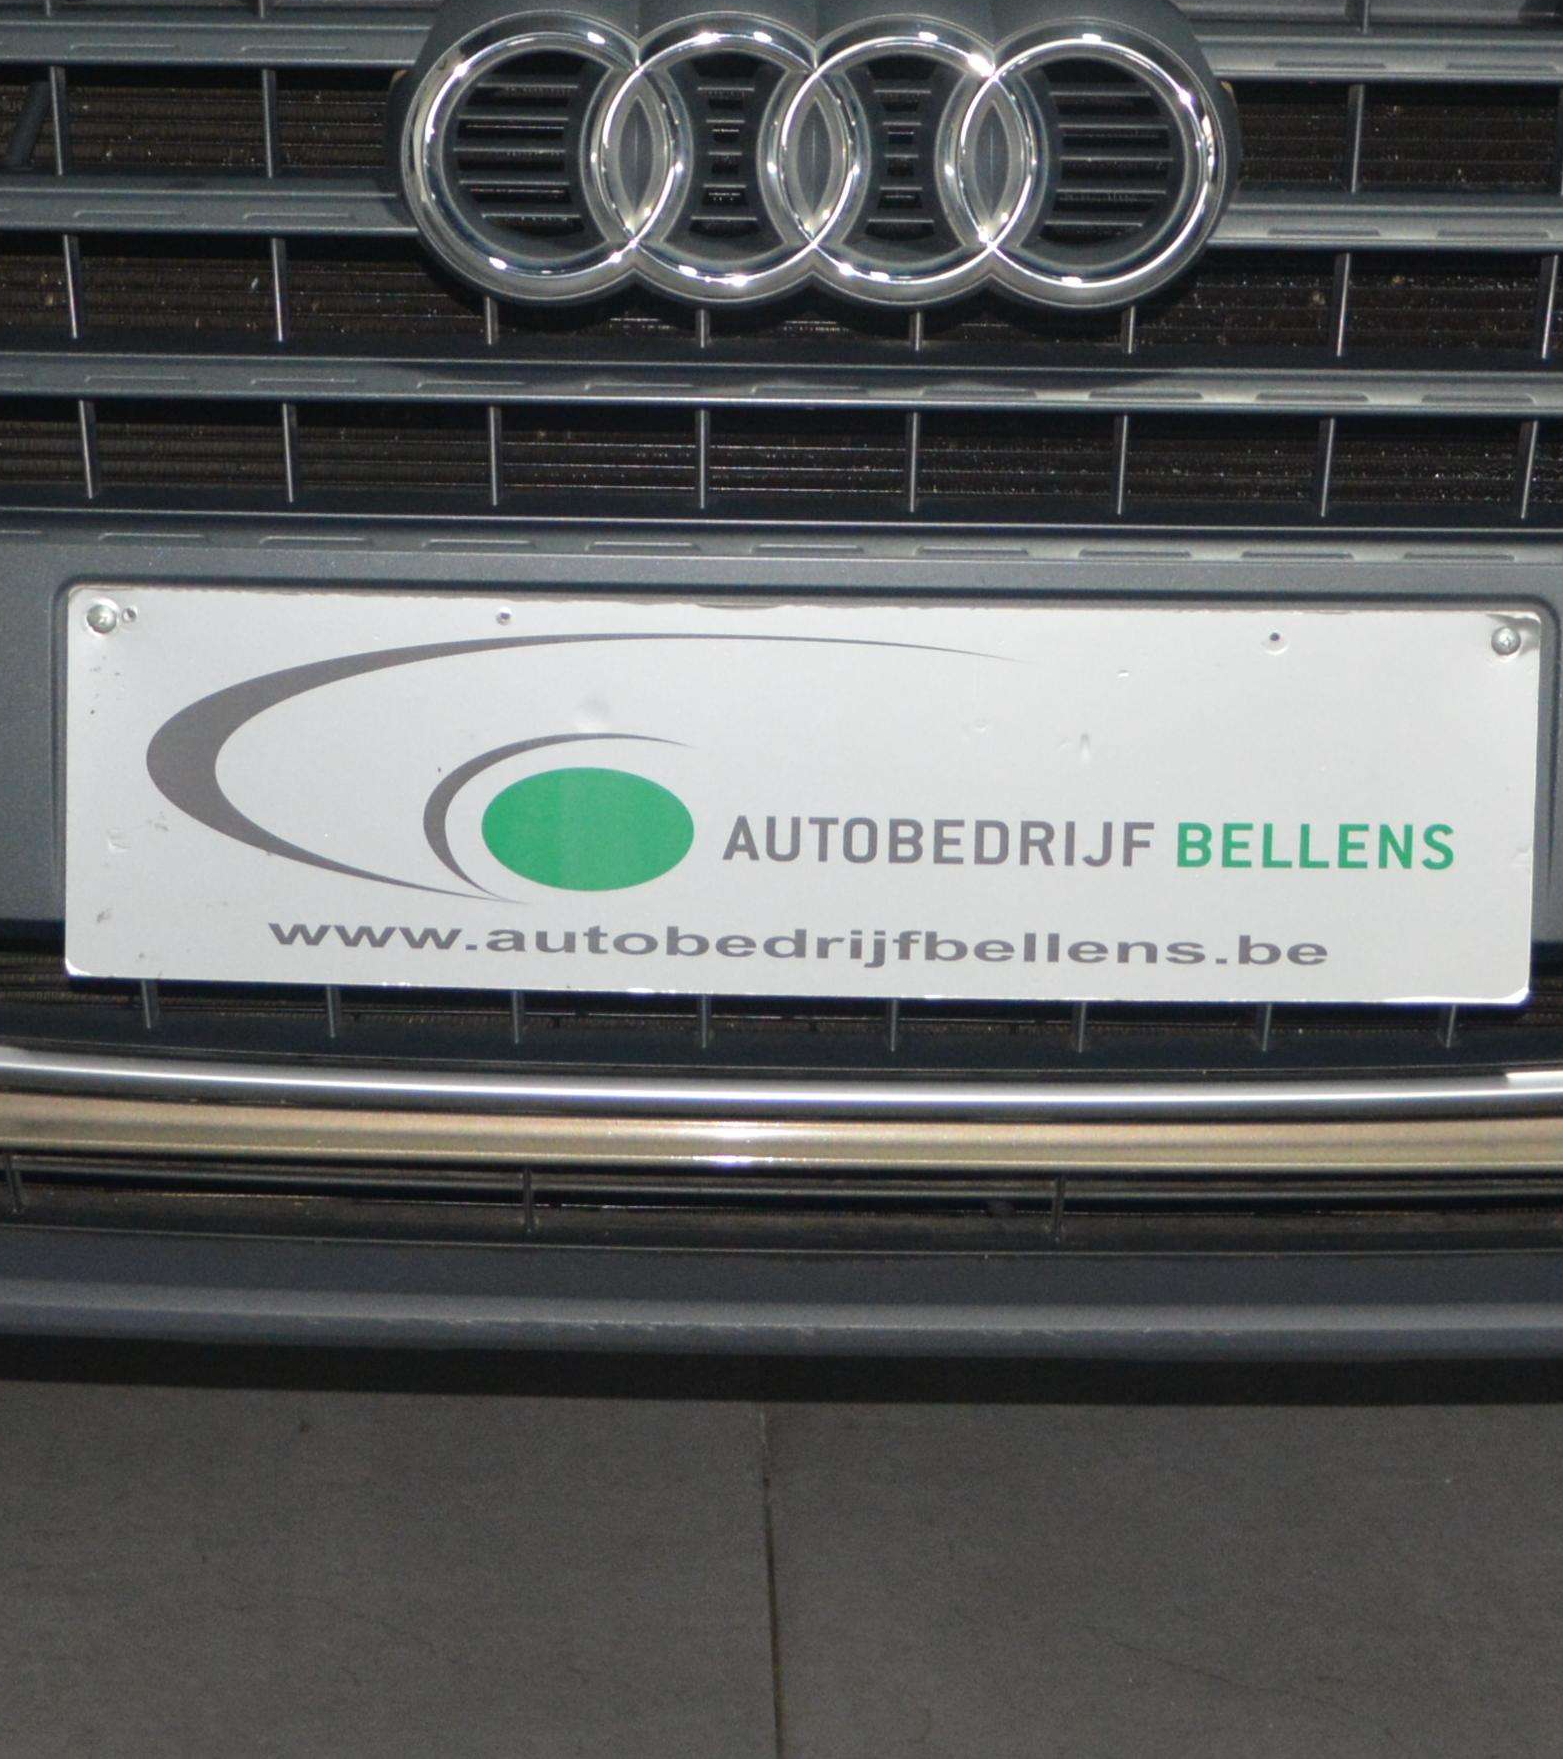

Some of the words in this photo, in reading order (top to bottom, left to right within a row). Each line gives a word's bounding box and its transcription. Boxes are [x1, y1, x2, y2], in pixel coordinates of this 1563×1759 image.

[721, 815, 1156, 868] AUTOBEDRIJF
[1175, 821, 1456, 871] BELLENS
[267, 922, 1330, 969] www.autobedrijfbellens.be
